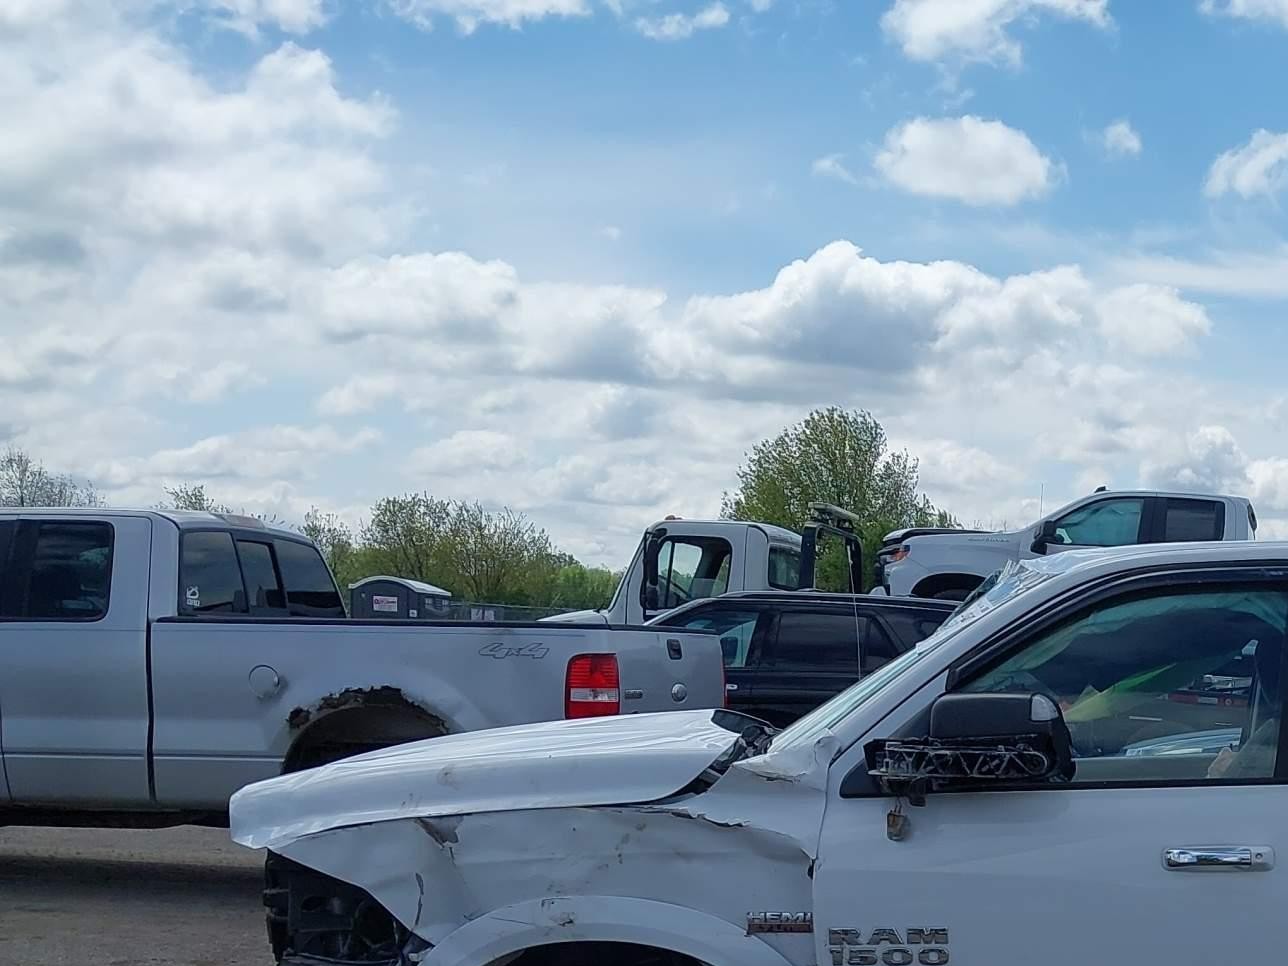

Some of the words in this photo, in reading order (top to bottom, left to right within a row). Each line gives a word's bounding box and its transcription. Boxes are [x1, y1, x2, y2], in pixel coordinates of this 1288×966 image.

[479, 642, 550, 659] 4x4
[747, 911, 812, 922] HEMI
[828, 927, 949, 945] RAM
[830, 948, 949, 966] 1500
